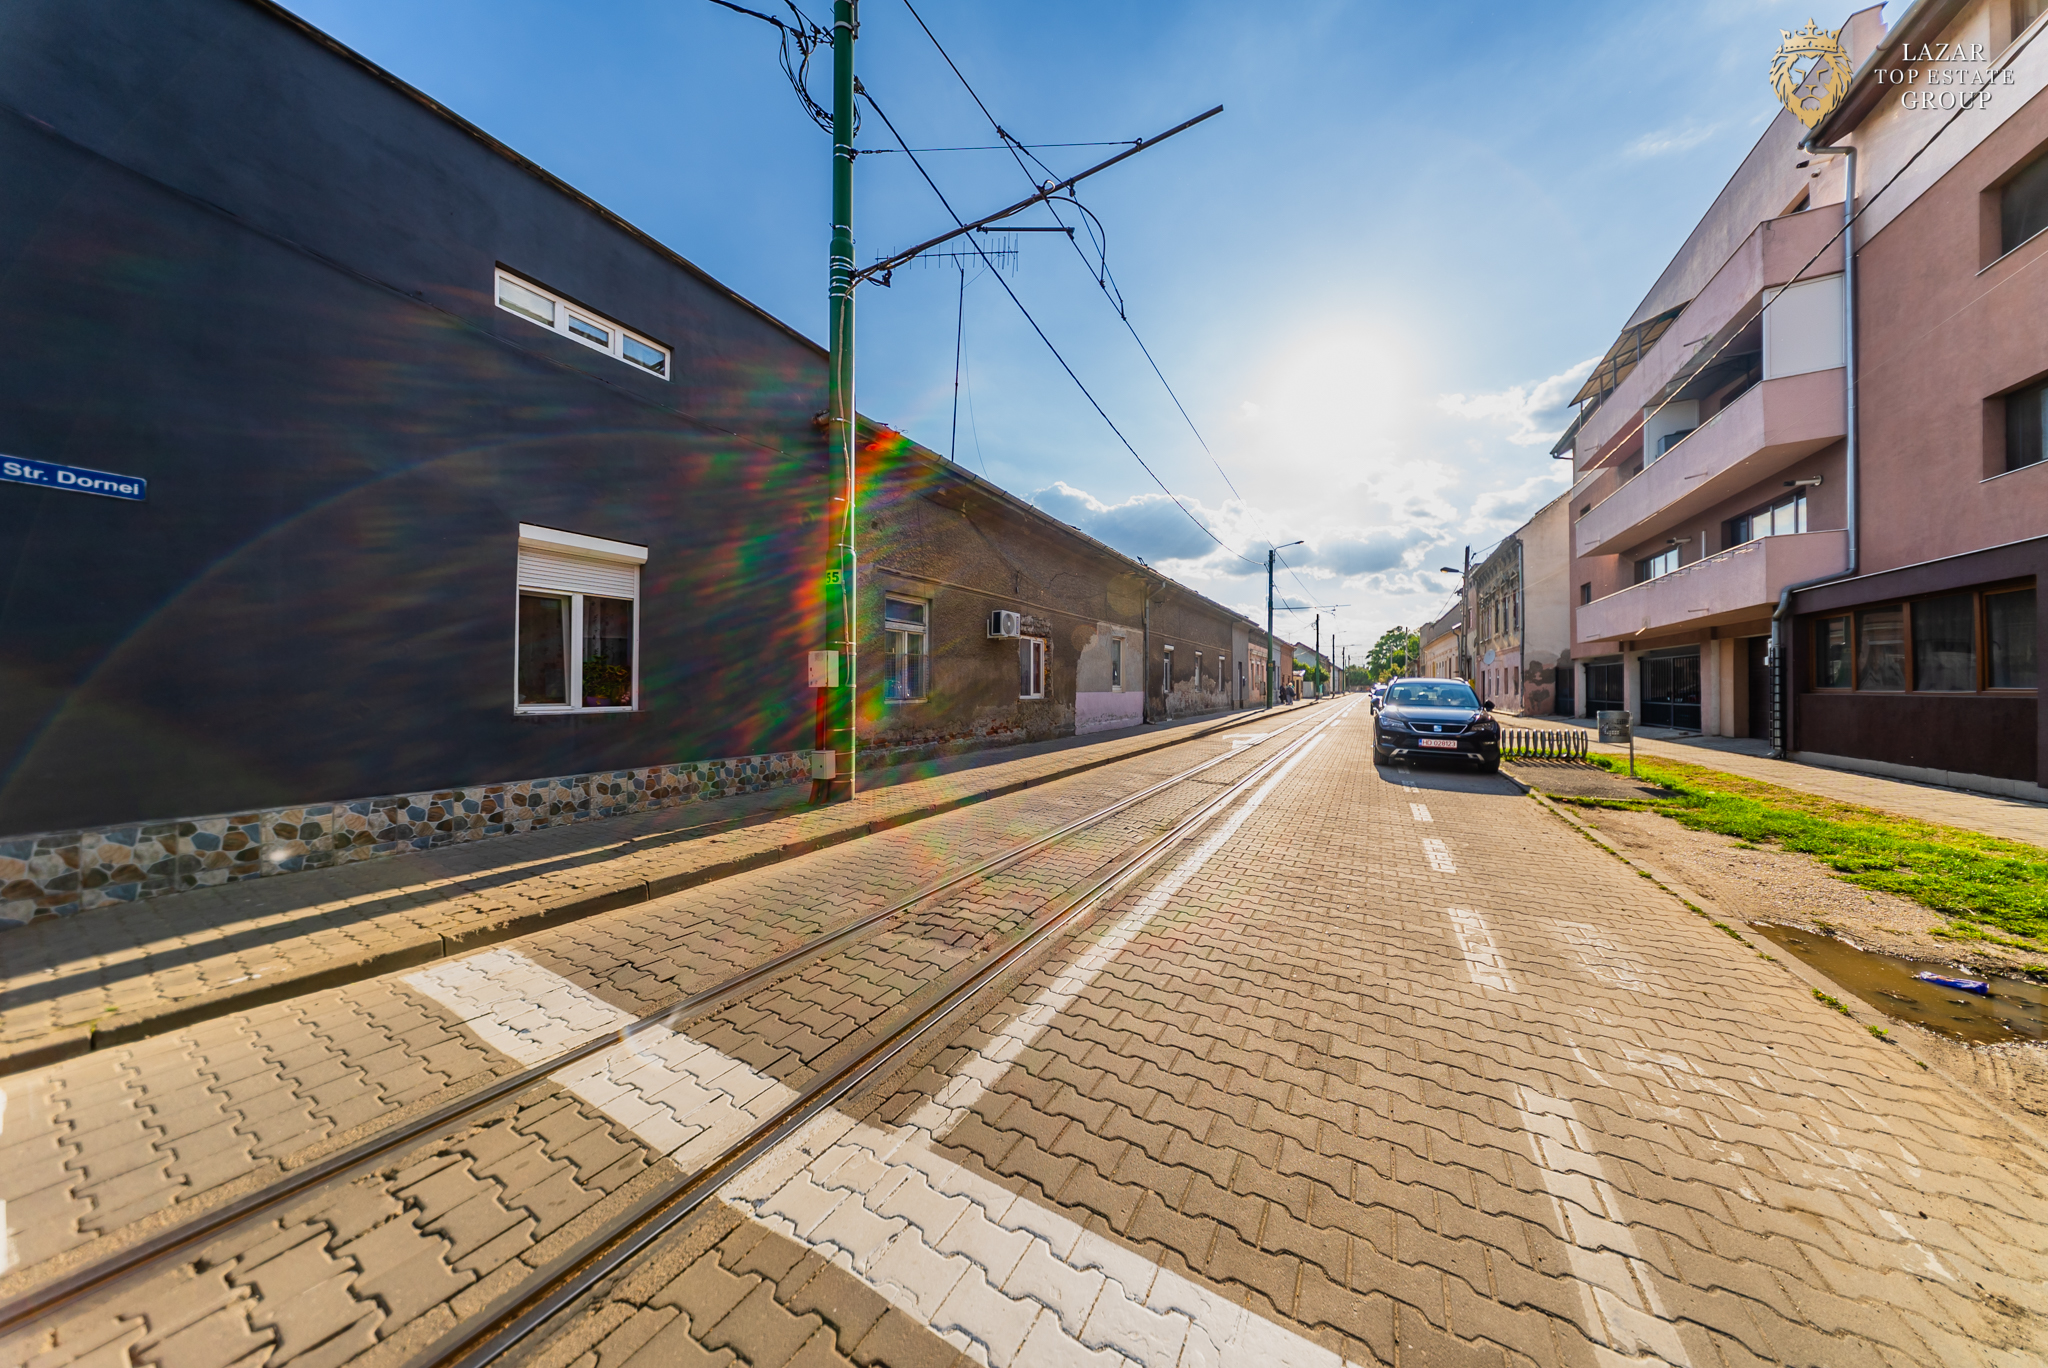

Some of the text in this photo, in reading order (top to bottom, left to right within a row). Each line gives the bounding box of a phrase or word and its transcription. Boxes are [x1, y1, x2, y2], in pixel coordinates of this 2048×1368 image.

[3, 461, 140, 495] Str. Dornei
[826, 571, 840, 584] 55
